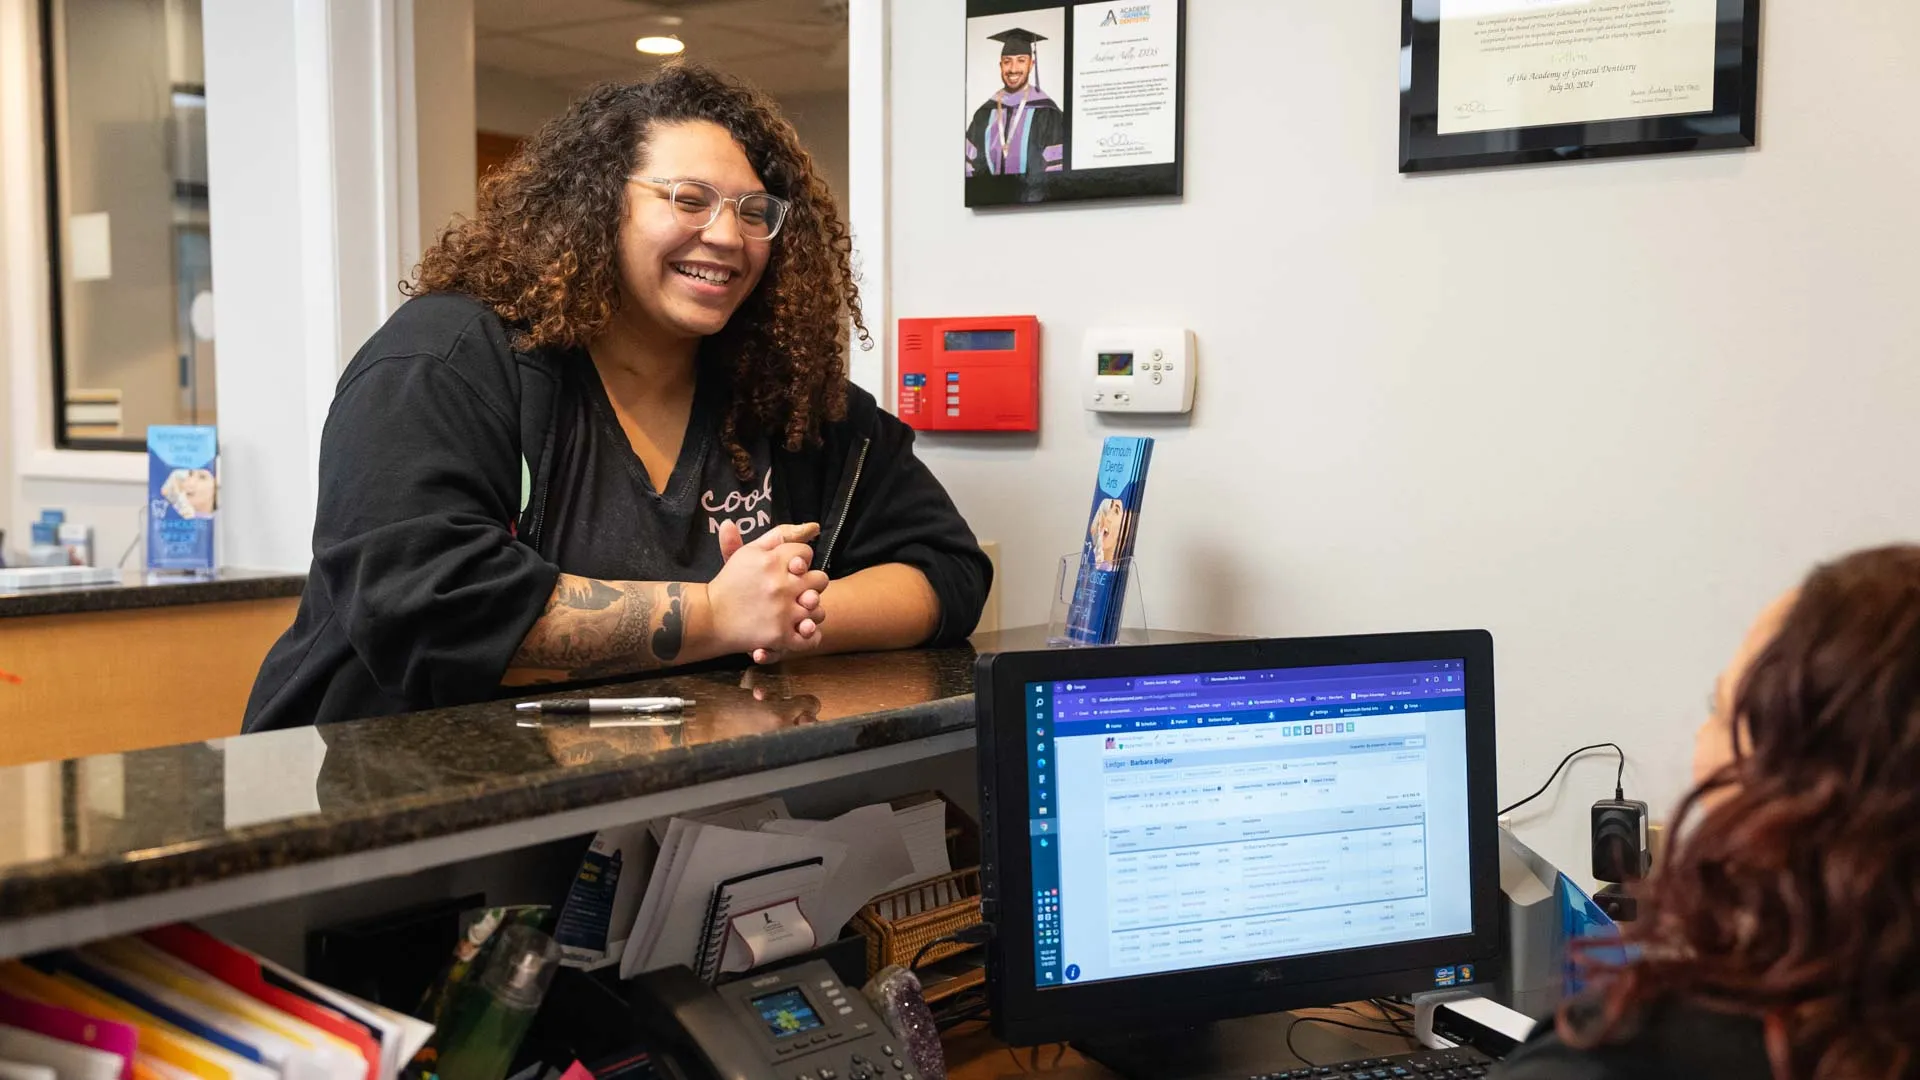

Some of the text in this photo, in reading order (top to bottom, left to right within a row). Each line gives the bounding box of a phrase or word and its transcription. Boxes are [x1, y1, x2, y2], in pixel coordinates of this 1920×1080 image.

[1507, 76, 1515, 85] of
[1528, 71, 1561, 80] Academy
[1562, 70, 1570, 79] of
[1571, 65, 1599, 79] General
[1601, 63, 1637, 75] Dentistry
[1548, 80, 1594, 93] July 20, 2024
[1105, 459, 1124, 473] Dental
[1105, 476, 1119, 489] Arts
[1105, 756, 1174, 769] Ledger Barbara Bolger
